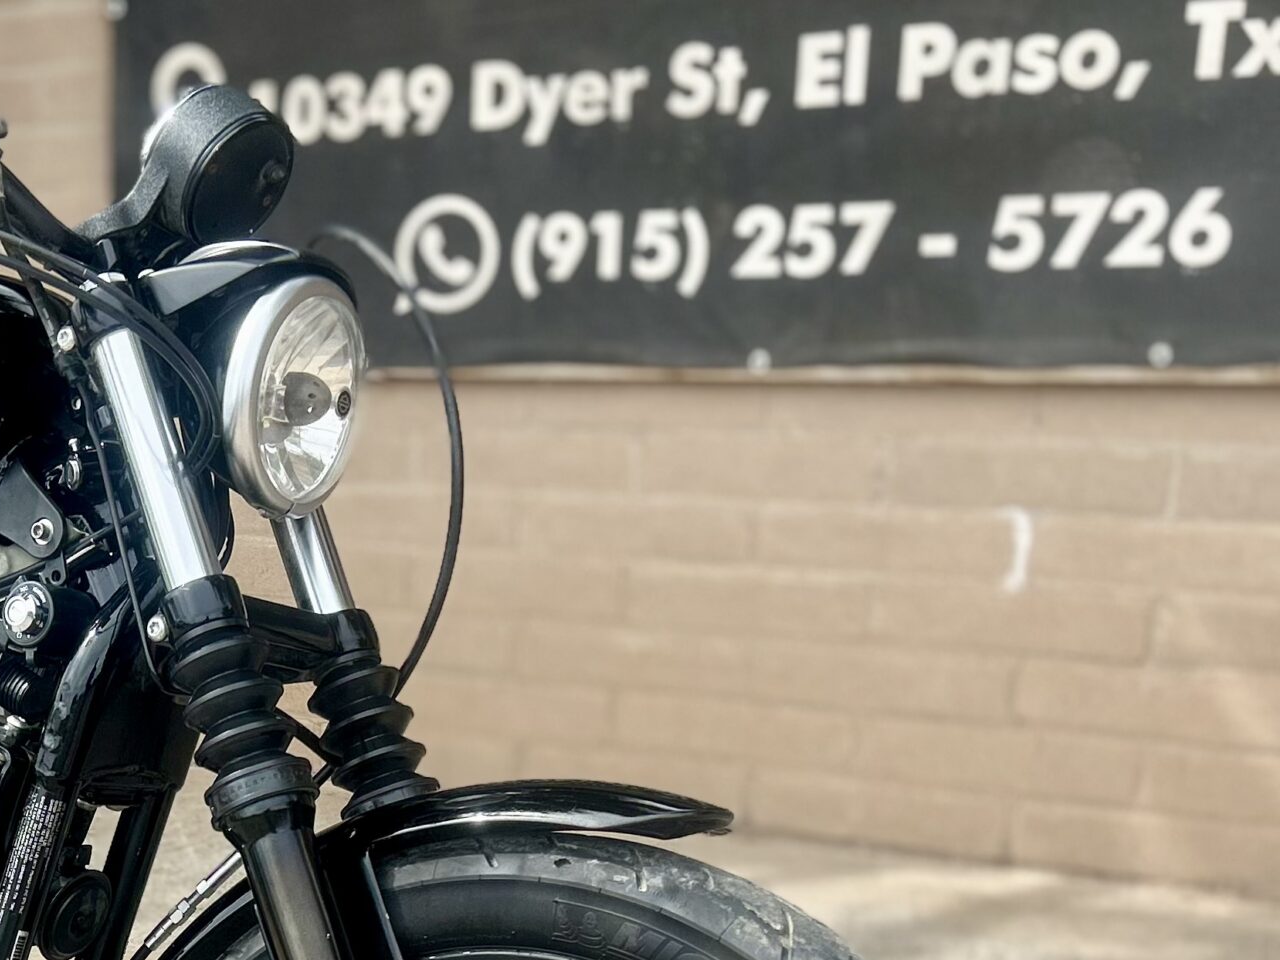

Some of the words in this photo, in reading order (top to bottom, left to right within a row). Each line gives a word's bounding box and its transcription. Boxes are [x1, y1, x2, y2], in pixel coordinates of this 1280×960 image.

[468, 58, 651, 148] Dyer
[665, 39, 770, 127] St,
[793, 23, 871, 109] El
[896, 21, 1151, 101] Paso,
[511, 207, 710, 301] (915)
[729, 200, 896, 280] 257
[986, 186, 1232, 274] 5726
